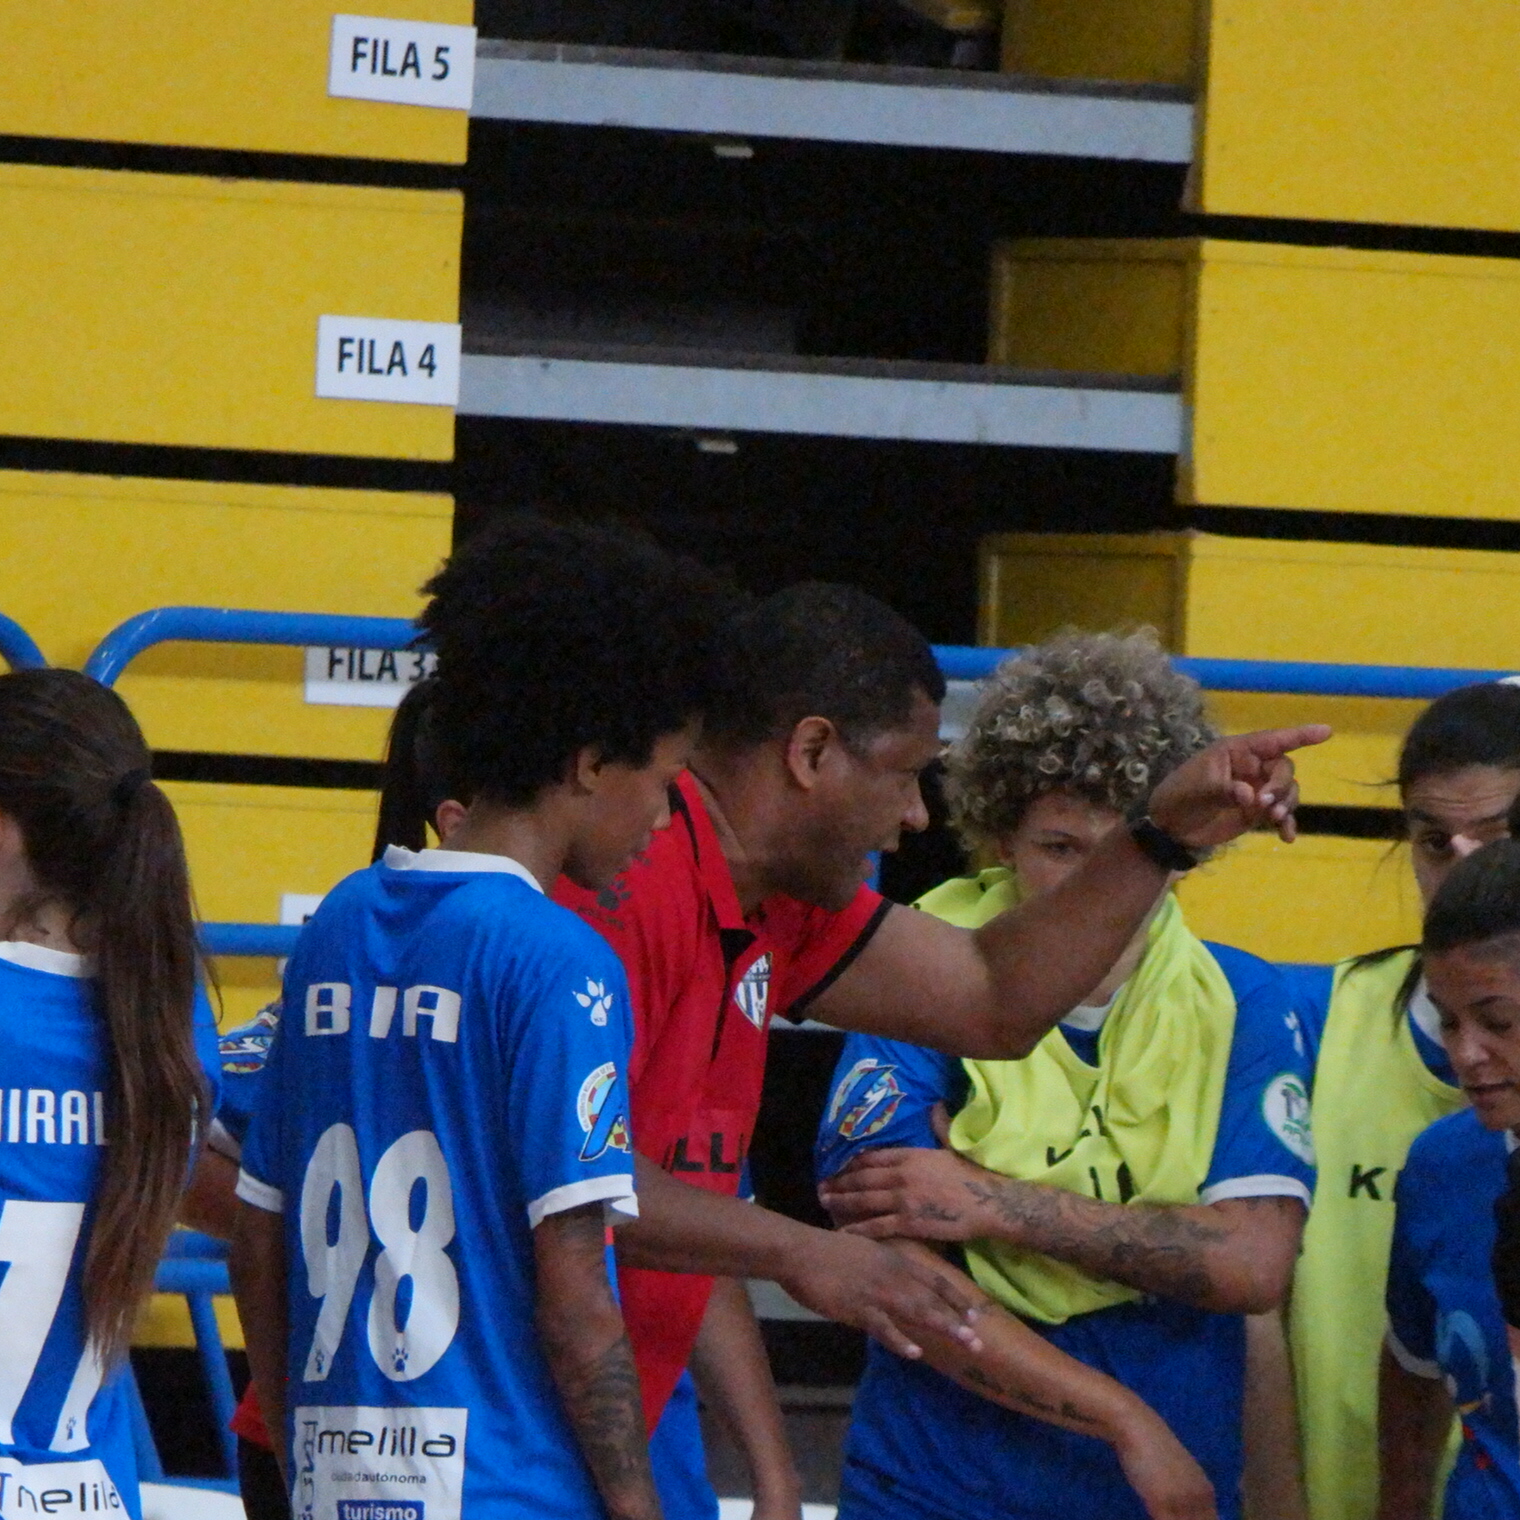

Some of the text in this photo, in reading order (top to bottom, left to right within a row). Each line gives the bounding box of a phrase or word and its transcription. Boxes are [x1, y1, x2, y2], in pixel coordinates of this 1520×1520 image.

[350, 36, 451, 81] FILA 5
[337, 336, 437, 378] FILA 4
[327, 648, 399, 682] FILA
[304, 982, 462, 1043] BIA
[299, 1122, 461, 1383] 98
[318, 1426, 456, 1457] melilla
